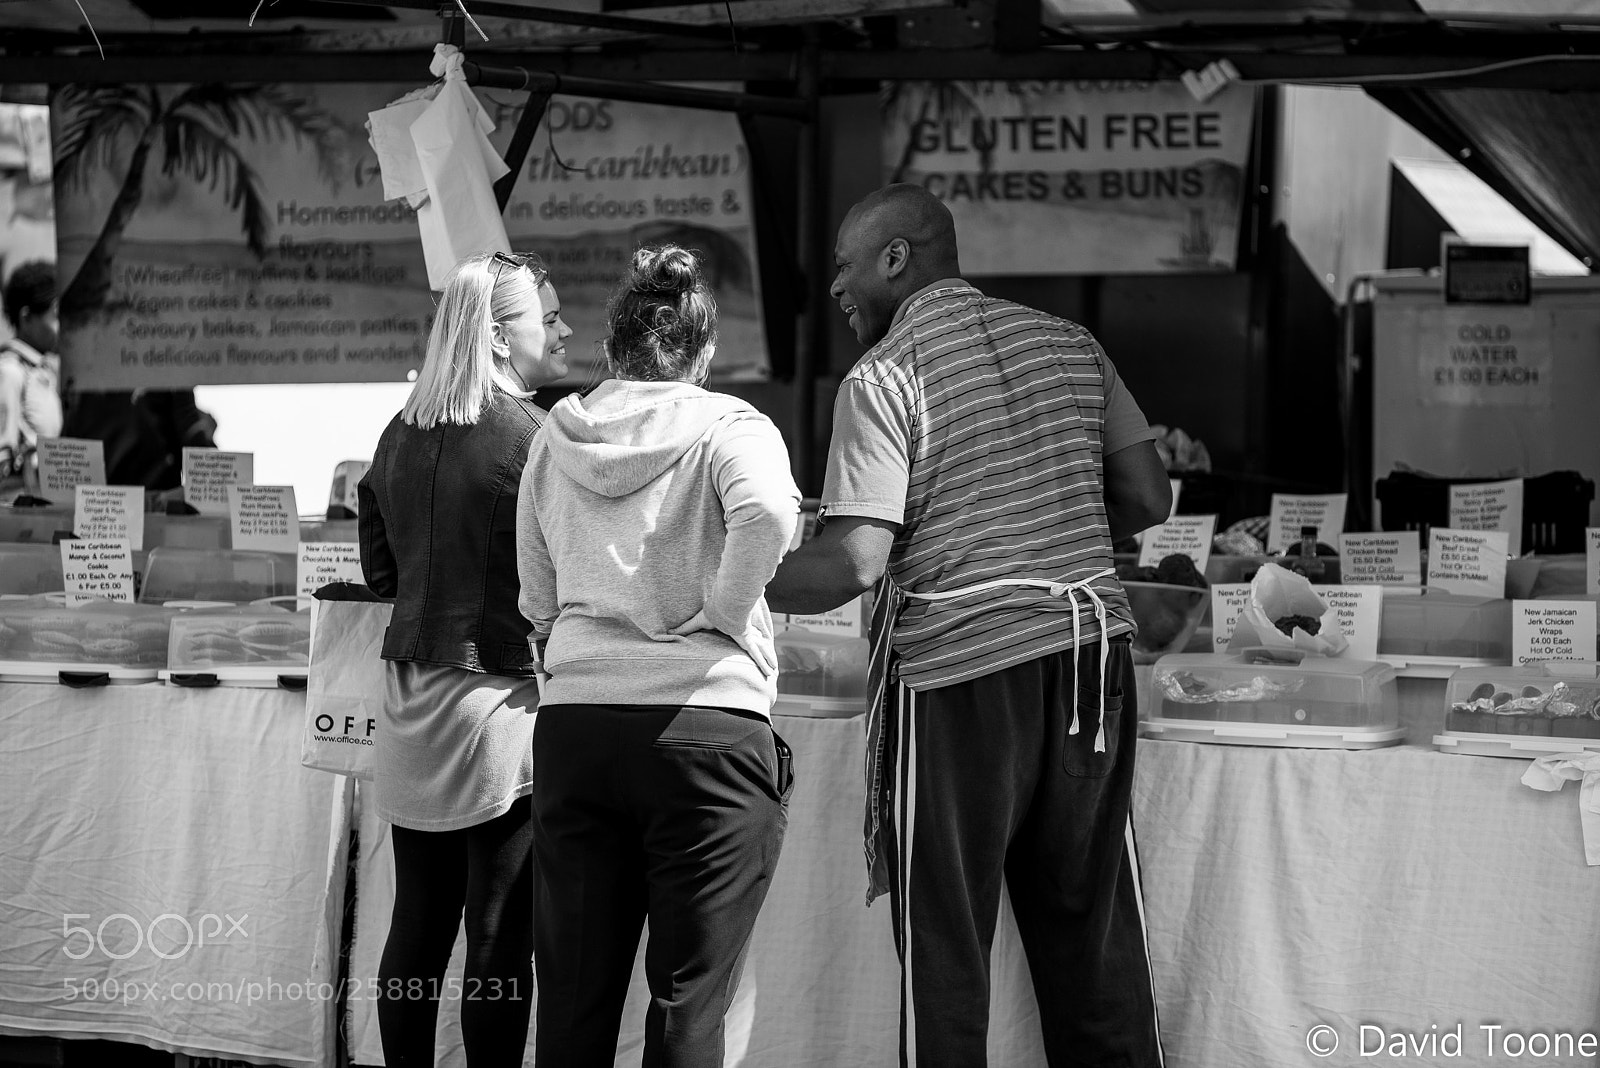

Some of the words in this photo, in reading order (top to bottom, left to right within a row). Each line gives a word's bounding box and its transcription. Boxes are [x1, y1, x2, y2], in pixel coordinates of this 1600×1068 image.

[911, 115, 1087, 153] GLUTEN
[1104, 112, 1222, 149] FREE
[528, 147, 574, 184] the
[925, 170, 1050, 200] CAKES
[1061, 171, 1086, 199] &
[1101, 168, 1204, 199] BUNS
[539, 193, 648, 221] delicious
[655, 191, 720, 217] taste
[723, 188, 742, 213] &
[279, 234, 373, 260] flavours
[303, 263, 318, 283] &
[188, 291, 239, 311] cakes
[245, 292, 258, 310] &
[265, 290, 333, 310] cookies
[269, 316, 355, 337] Jamaican
[1458, 324, 1511, 342] COLD
[121, 347, 138, 366] In
[143, 345, 221, 367] delicious
[303, 344, 339, 364] and
[1452, 345, 1518, 364] WATER
[1434, 367, 1482, 386] £1.00
[1485, 367, 1539, 386] EACH
[1452, 534, 1488, 543] Caribbean
[68, 553, 90, 562] Mango
[120, 573, 132, 581] Any
[1430, 571, 1459, 579] Contains
[1540, 628, 1563, 636] Wraps
[315, 714, 376, 736] OFF
[314, 735, 376, 746] www.office.co.
